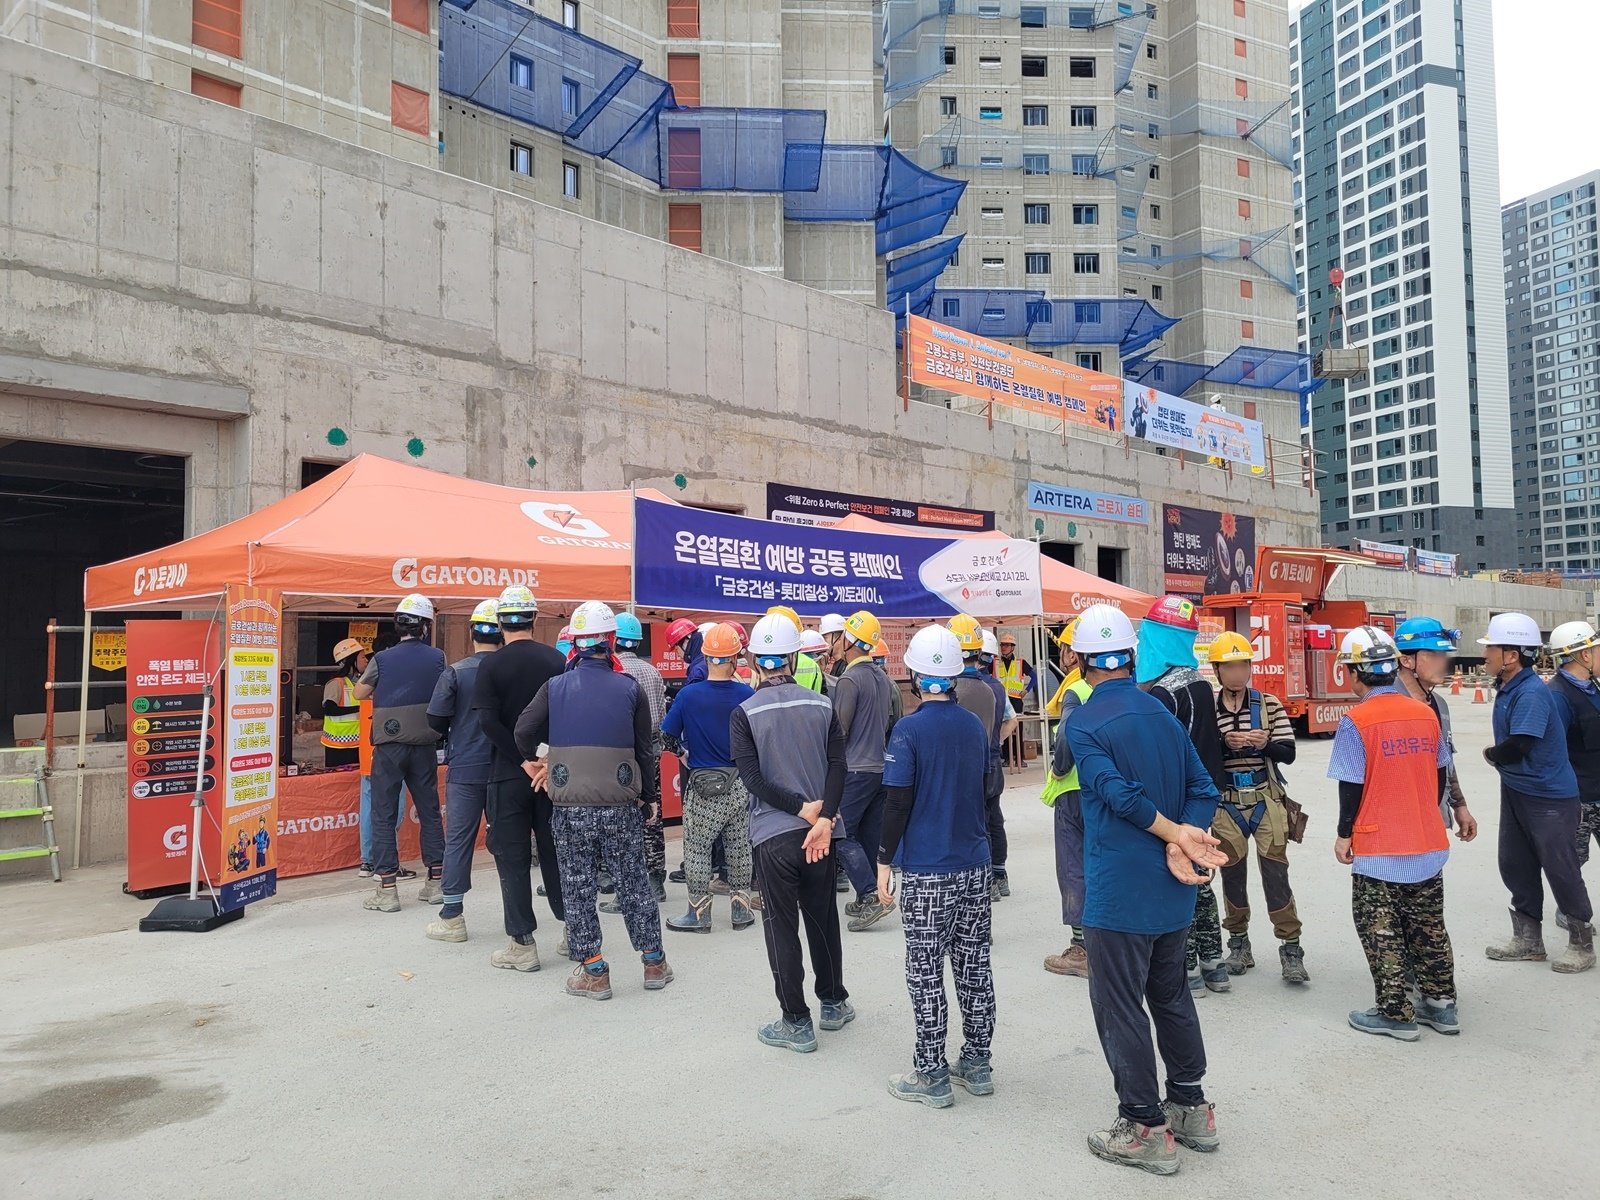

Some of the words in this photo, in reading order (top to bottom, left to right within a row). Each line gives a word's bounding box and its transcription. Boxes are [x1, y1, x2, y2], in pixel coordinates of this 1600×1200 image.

[925, 341, 967, 367] 고용노동부,
[970, 354, 1014, 378] 안전보건공단
[926, 357, 973, 384] 금호건설과
[975, 371, 1010, 393] 함께하는
[1012, 381, 1045, 402] 온열질환
[1046, 391, 1062, 407] 예방
[1064, 395, 1087, 413] 캠페인
[1151, 417, 1169, 433] 더위는
[802, 496, 818, 507] Zero
[818, 498, 825, 508] &
[826, 500, 850, 512] Perfect
[850, 502, 872, 513] 안전보건
[874, 505, 890, 516] 캠페인
[890, 507, 901, 517] 구호
[1034, 490, 1092, 510] ARTERA
[1096, 498, 1123, 516] 근로자
[1128, 503, 1143, 518] 쉼터
[520, 501, 611, 538] G
[537, 535, 632, 550] GATORA
[1173, 532, 1184, 548] 캡틴
[1186, 534, 1201, 549] 방패도
[674, 530, 762, 571] 온열질환
[765, 544, 805, 574] 예방
[809, 548, 848, 577] 공동
[850, 552, 904, 580] 캠페인
[972, 556, 1003, 567] 금호건설
[1166, 552, 1184, 570] 더위는
[1186, 554, 1208, 571] 못막는다!
[146, 562, 188, 592] 게토레이
[392, 557, 418, 588] G
[420, 564, 540, 588] GATORADE
[1002, 572, 1030, 580] 2A12BL
[1270, 562, 1279, 580] G
[1280, 561, 1314, 584] 게토레이
[1071, 592, 1080, 610] G
[231, 620, 257, 631] 금호건설과
[258, 622, 277, 632] 함께하는
[230, 634, 252, 644] 온열질환
[252, 634, 262, 644] 예방
[264, 636, 278, 645] 캠페인
[663, 652, 675, 660] 폭염
[149, 660, 170, 671] 폭염
[173, 659, 199, 671] 탈출!
[656, 662, 669, 670] 안전
[670, 662, 682, 670] 온도
[136, 674, 159, 686] 안전
[161, 673, 183, 685] 온도
[185, 672, 211, 684] 체크!
[240, 671, 255, 682] 1시간
[256, 671, 267, 682] 작업
[234, 684, 248, 696] 10분
[249, 684, 260, 696] 이상
[260, 684, 272, 695] 휴식
[240, 723, 254, 735] 1시간
[255, 722, 266, 734] 작업
[248, 736, 260, 748] 이상
[260, 735, 271, 747] 휴식
[277, 812, 360, 836] GATORAD
[165, 850, 186, 858] 게토레이
